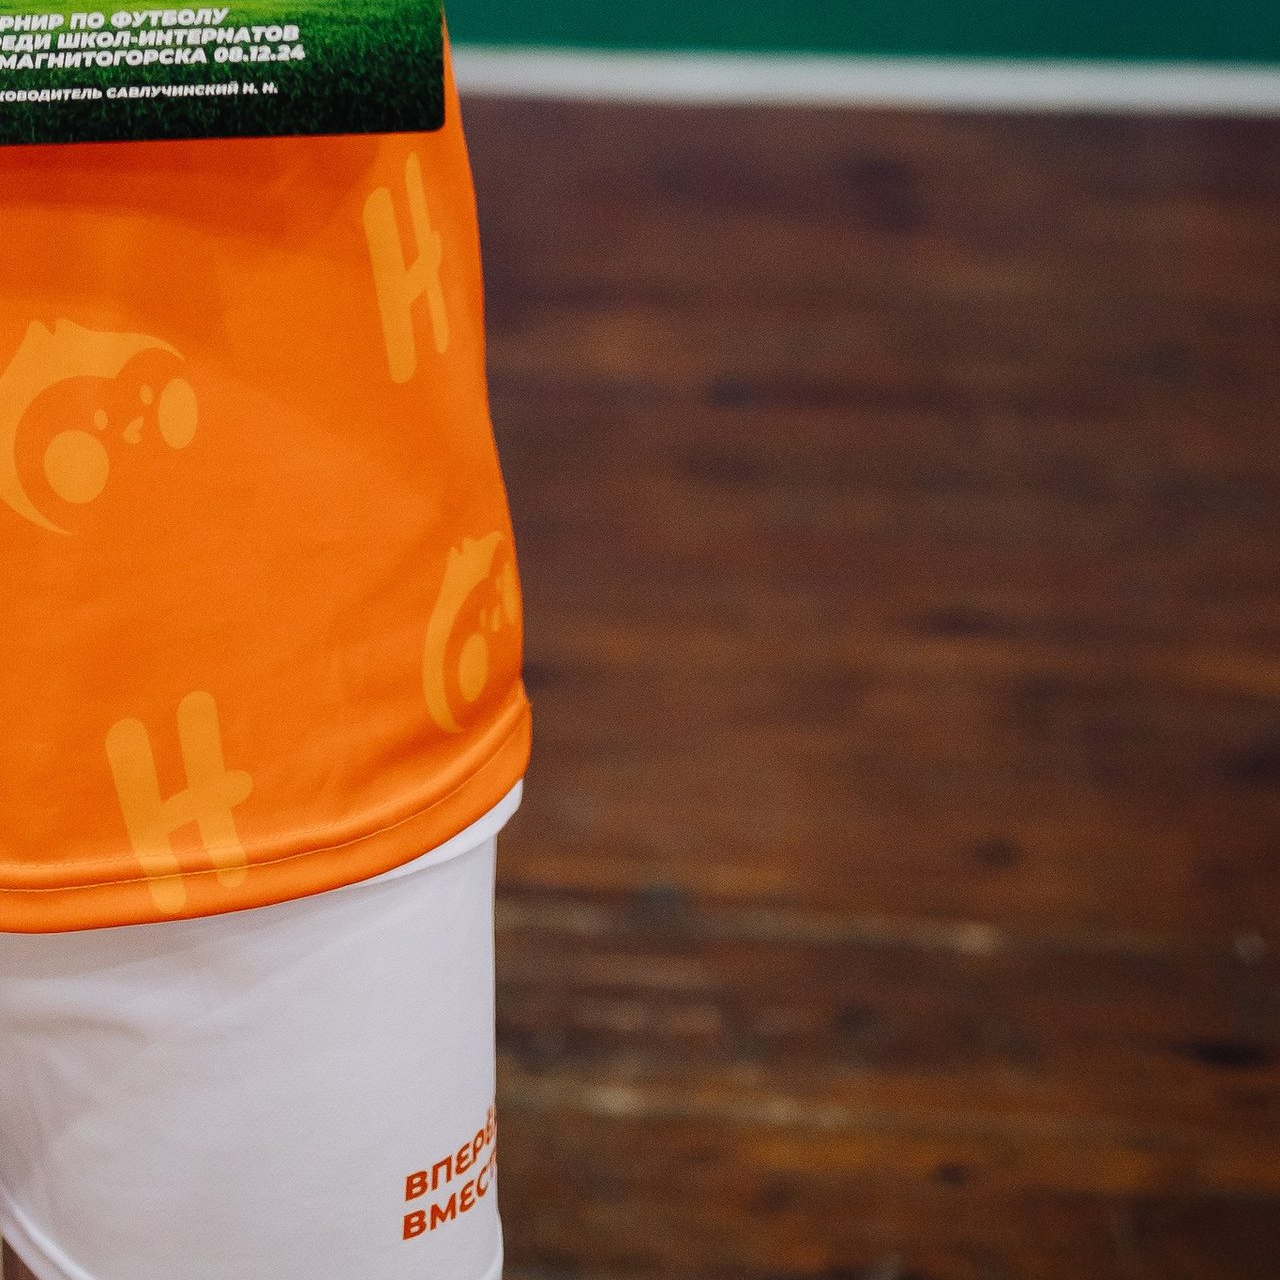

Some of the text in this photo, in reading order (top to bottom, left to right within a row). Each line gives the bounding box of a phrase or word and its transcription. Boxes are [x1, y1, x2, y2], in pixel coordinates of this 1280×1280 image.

[70, 12, 108, 30] ПО
[110, 8, 230, 28] ФУТБОЛУ
[57, 25, 299, 50] ШКОЛ-ИНТЕРНАТОВ
[213, 44, 306, 64] 08.12.24
[106, 81, 239, 99] САВЛУЧИНСКИЙ
[404, 1107, 496, 1202] ВПЕР
